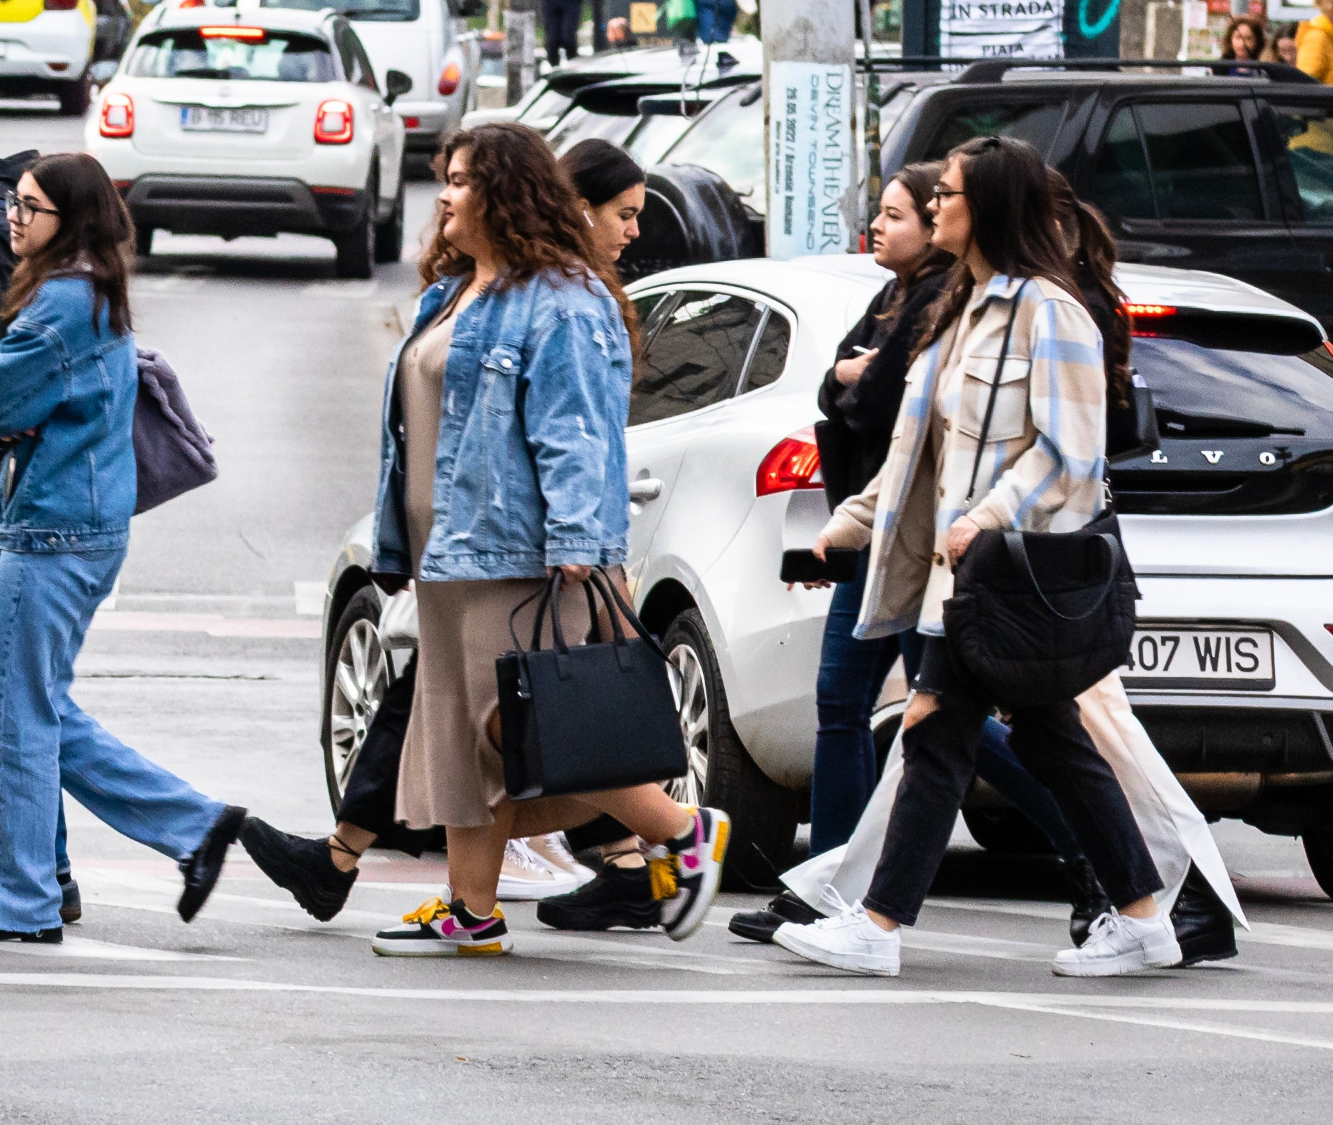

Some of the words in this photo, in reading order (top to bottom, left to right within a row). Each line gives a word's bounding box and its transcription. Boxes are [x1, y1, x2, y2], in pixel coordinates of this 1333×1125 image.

[810, 74, 819, 131] DEVIN
[824, 68, 844, 148] DREAM
[807, 139, 817, 250] TOWNSEND
[820, 152, 843, 252] THEATER
[1150, 449, 1276, 466] LVO
[1193, 636, 1260, 672] WIS
